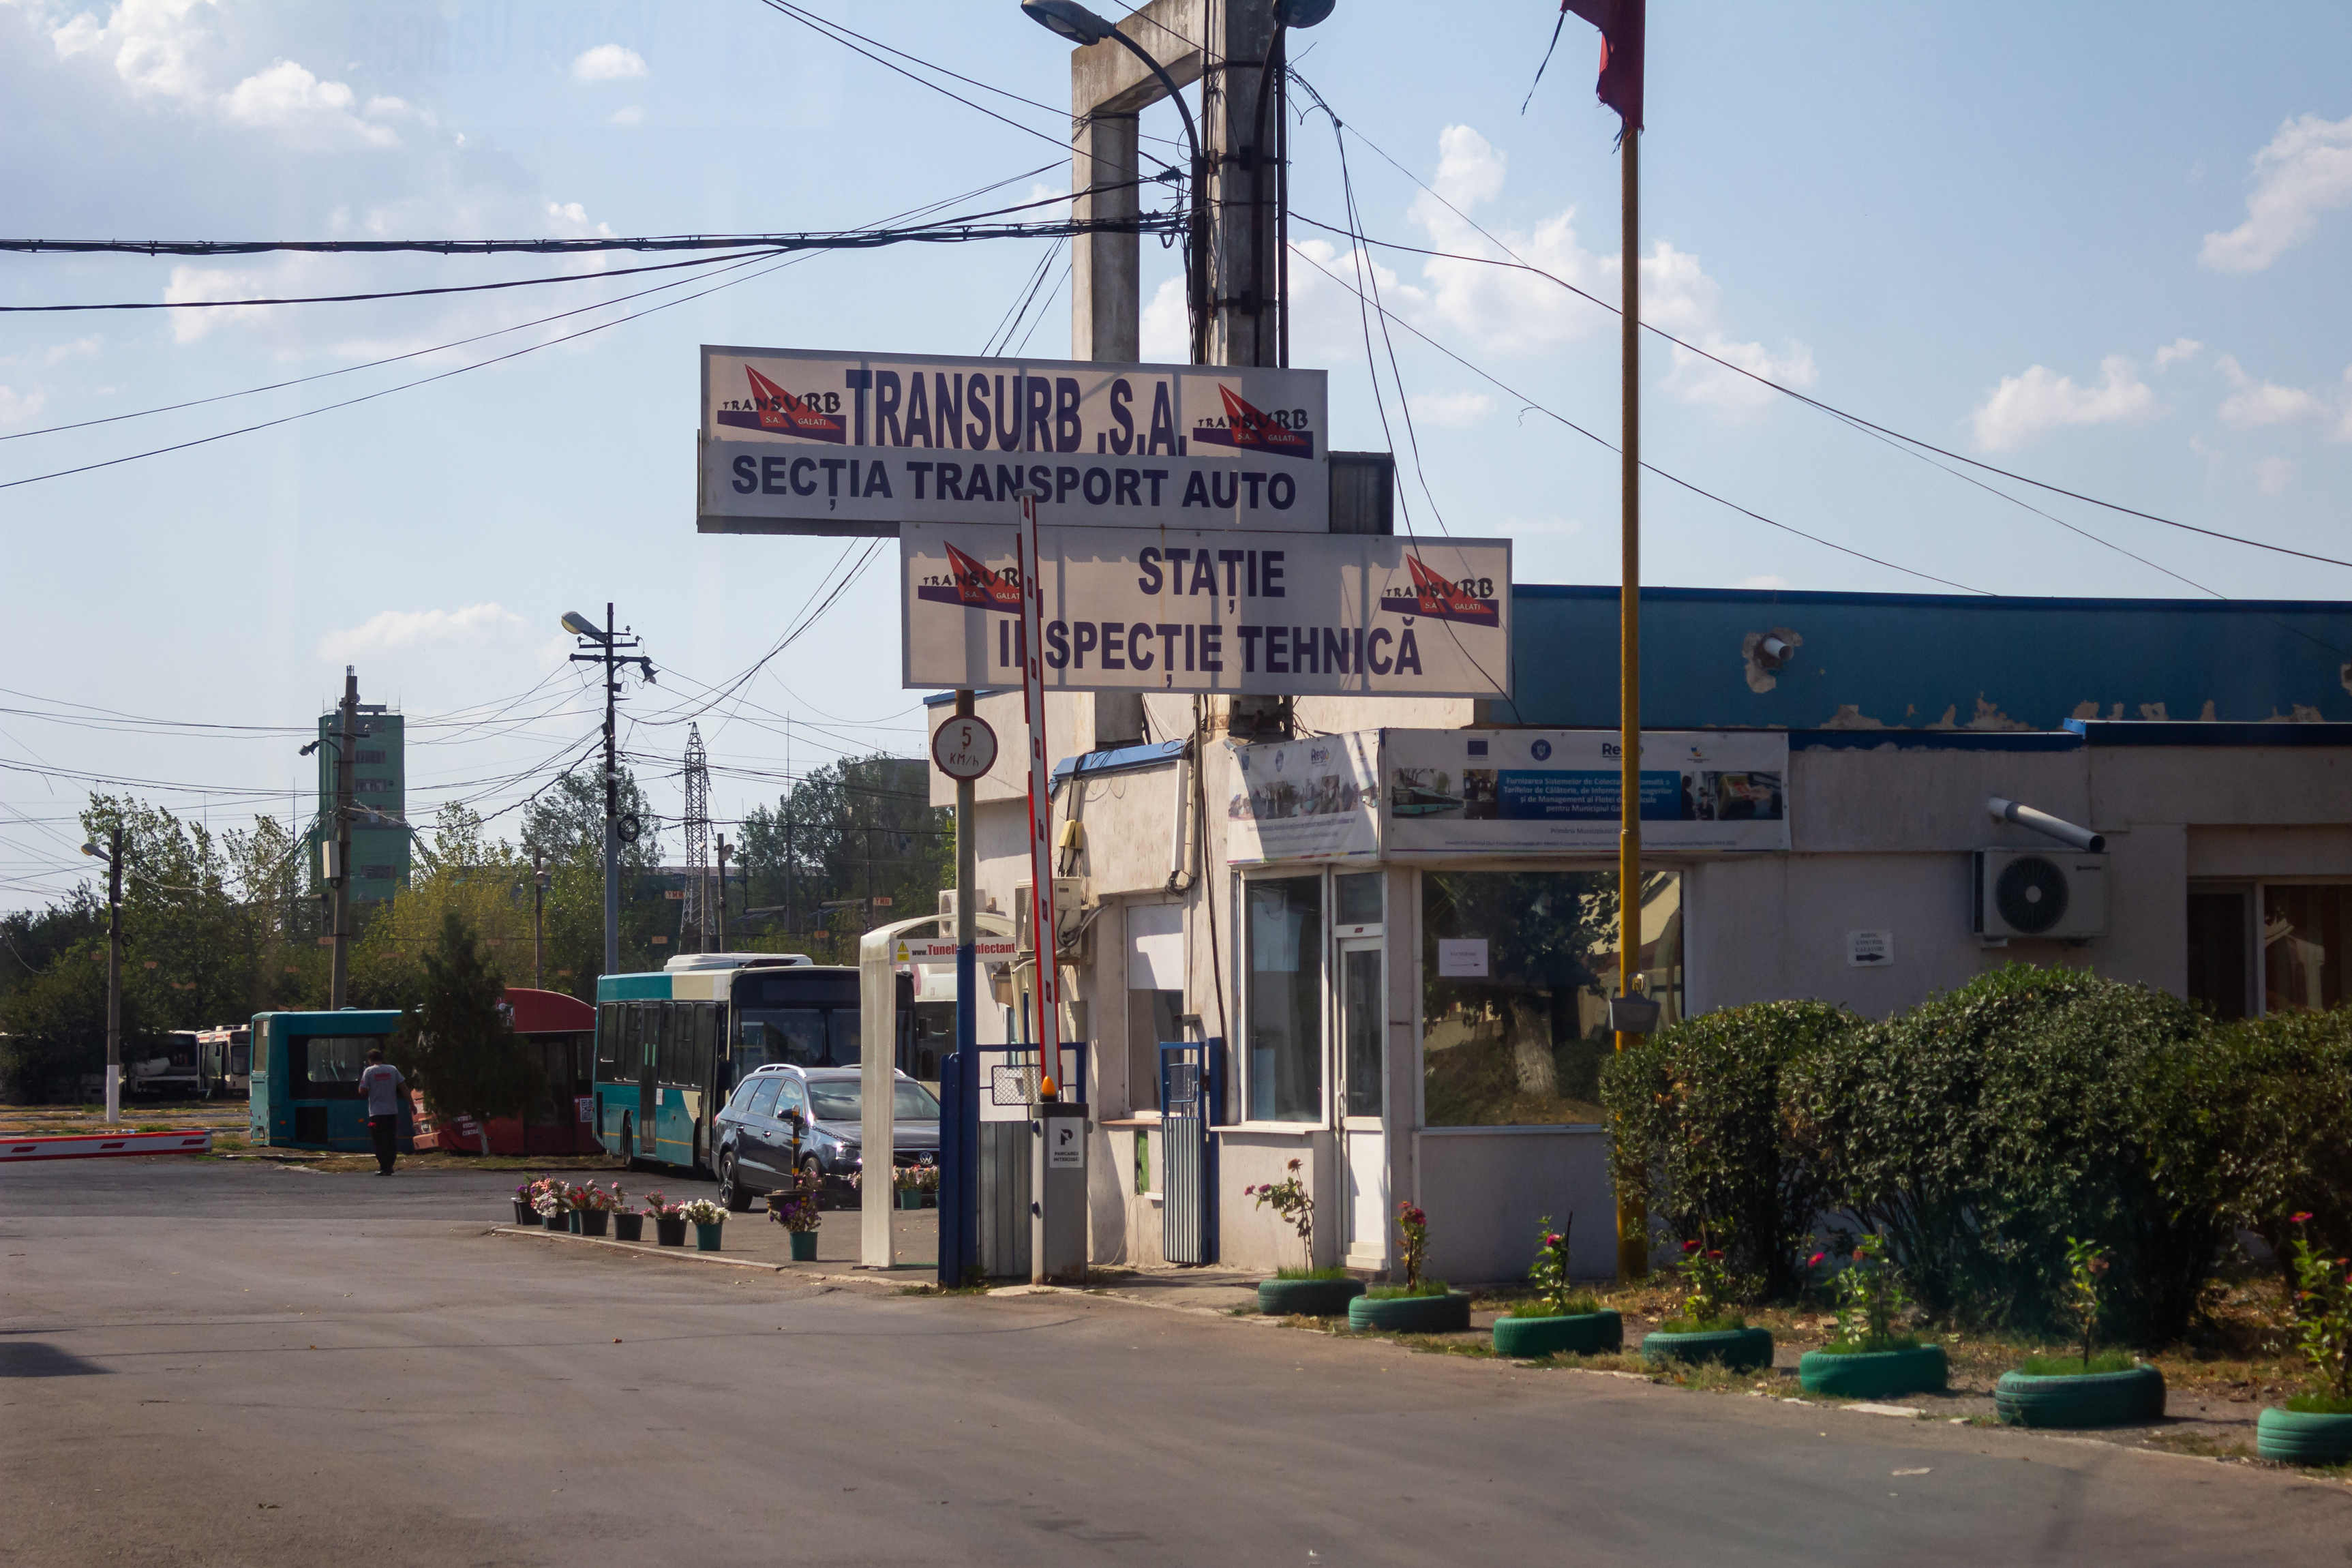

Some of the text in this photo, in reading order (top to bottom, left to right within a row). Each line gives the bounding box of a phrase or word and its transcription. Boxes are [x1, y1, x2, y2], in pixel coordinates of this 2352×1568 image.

[723, 391, 841, 414] TRANSURB
[846, 369, 1082, 453] TRANSURB
[798, 418, 826, 426] GALATI
[1197, 408, 1308, 429] TRANSURB
[732, 455, 1296, 511] SECȚIA TRANSPORT AUTO
[922, 567, 1021, 588] TRANSUR
[1138, 547, 1285, 615] STAȚIE
[1385, 577, 1494, 599] TRANSURB
[1237, 616, 1423, 676] TEHNICĂ
[962, 726, 972, 747] 5
[1539, 796, 1585, 804] Management
